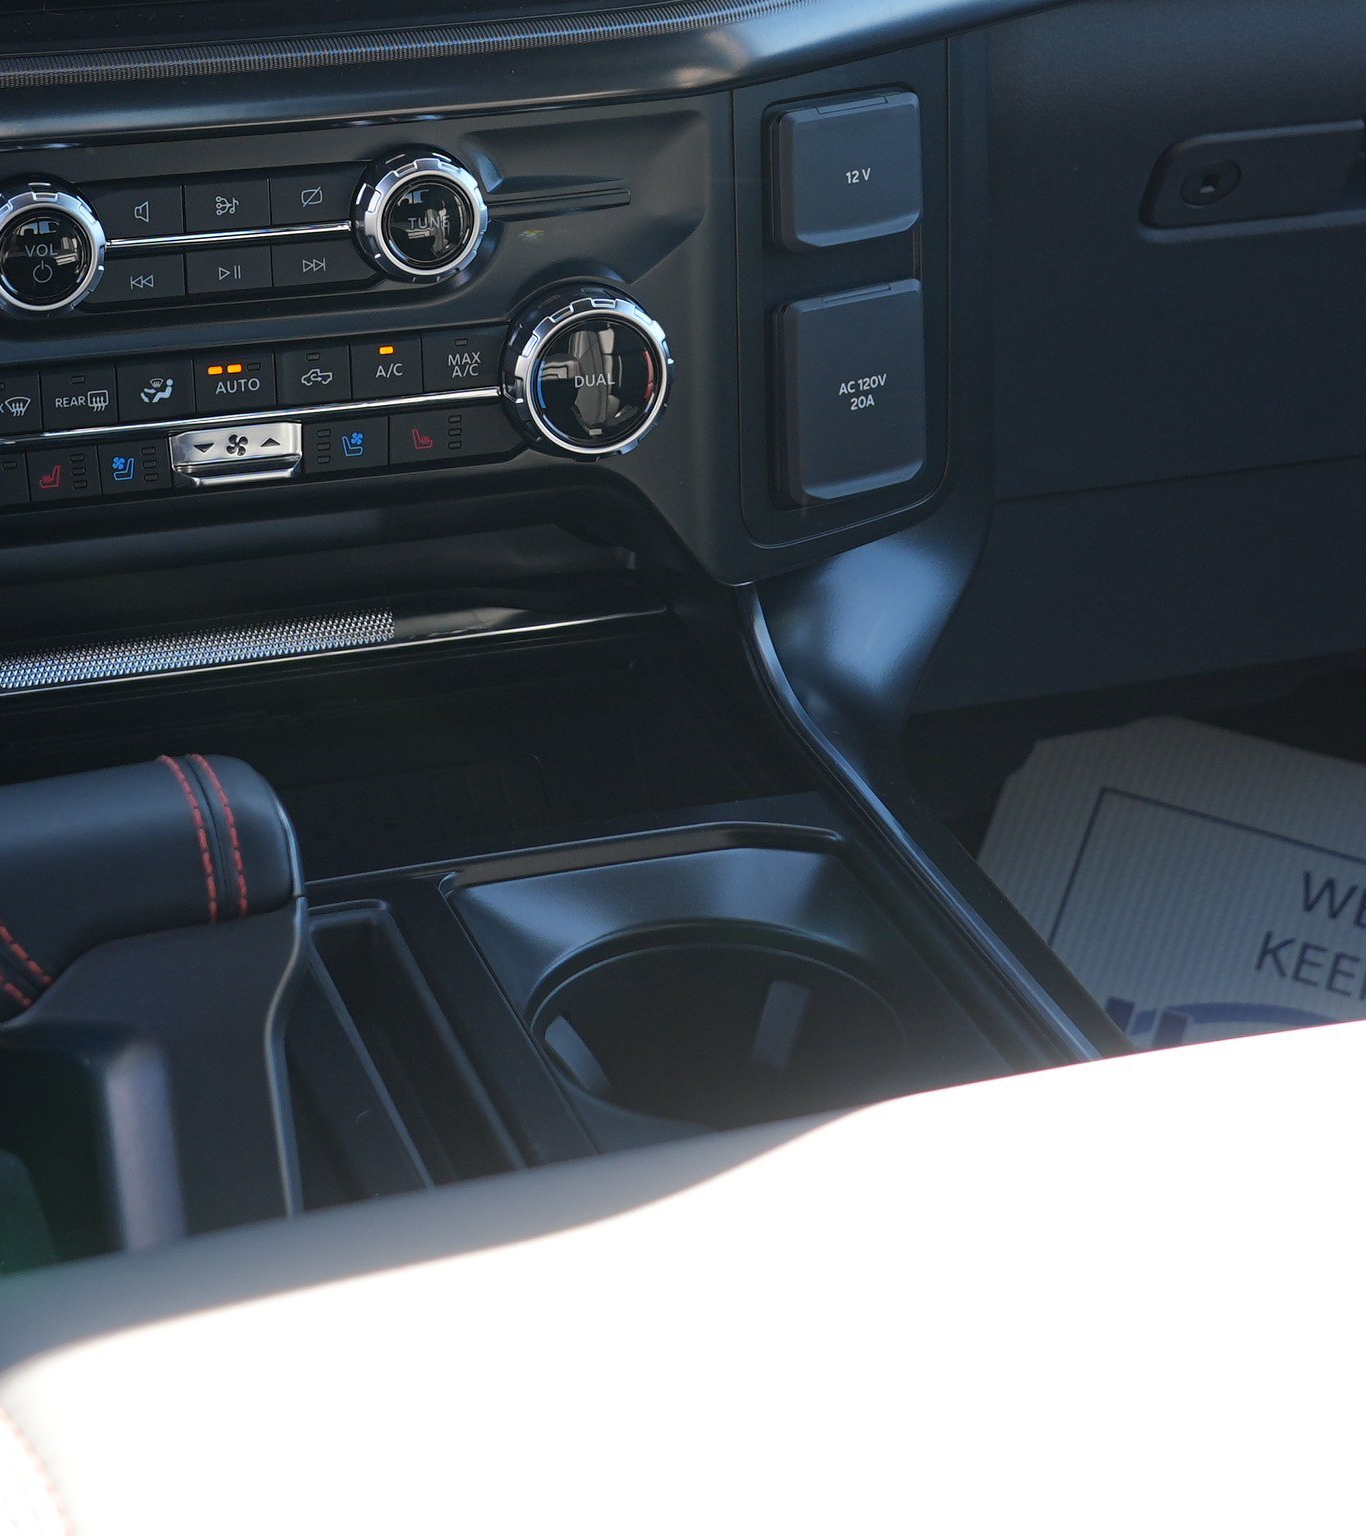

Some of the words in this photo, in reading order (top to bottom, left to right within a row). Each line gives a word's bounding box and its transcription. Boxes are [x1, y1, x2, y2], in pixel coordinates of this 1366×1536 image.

[846, 170, 859, 183] 12
[861, 168, 871, 181] V
[407, 216, 450, 231] TUNE
[24, 243, 58, 258] VOL
[448, 352, 481, 366] MAX
[375, 363, 403, 378] A/C
[451, 364, 479, 378] A/C
[215, 378, 260, 394] AUTO
[574, 374, 615, 388] DUAL
[838, 380, 856, 395] AC
[858, 374, 887, 391] 120V
[55, 396, 85, 408] REAR
[850, 395, 874, 410] 20A
